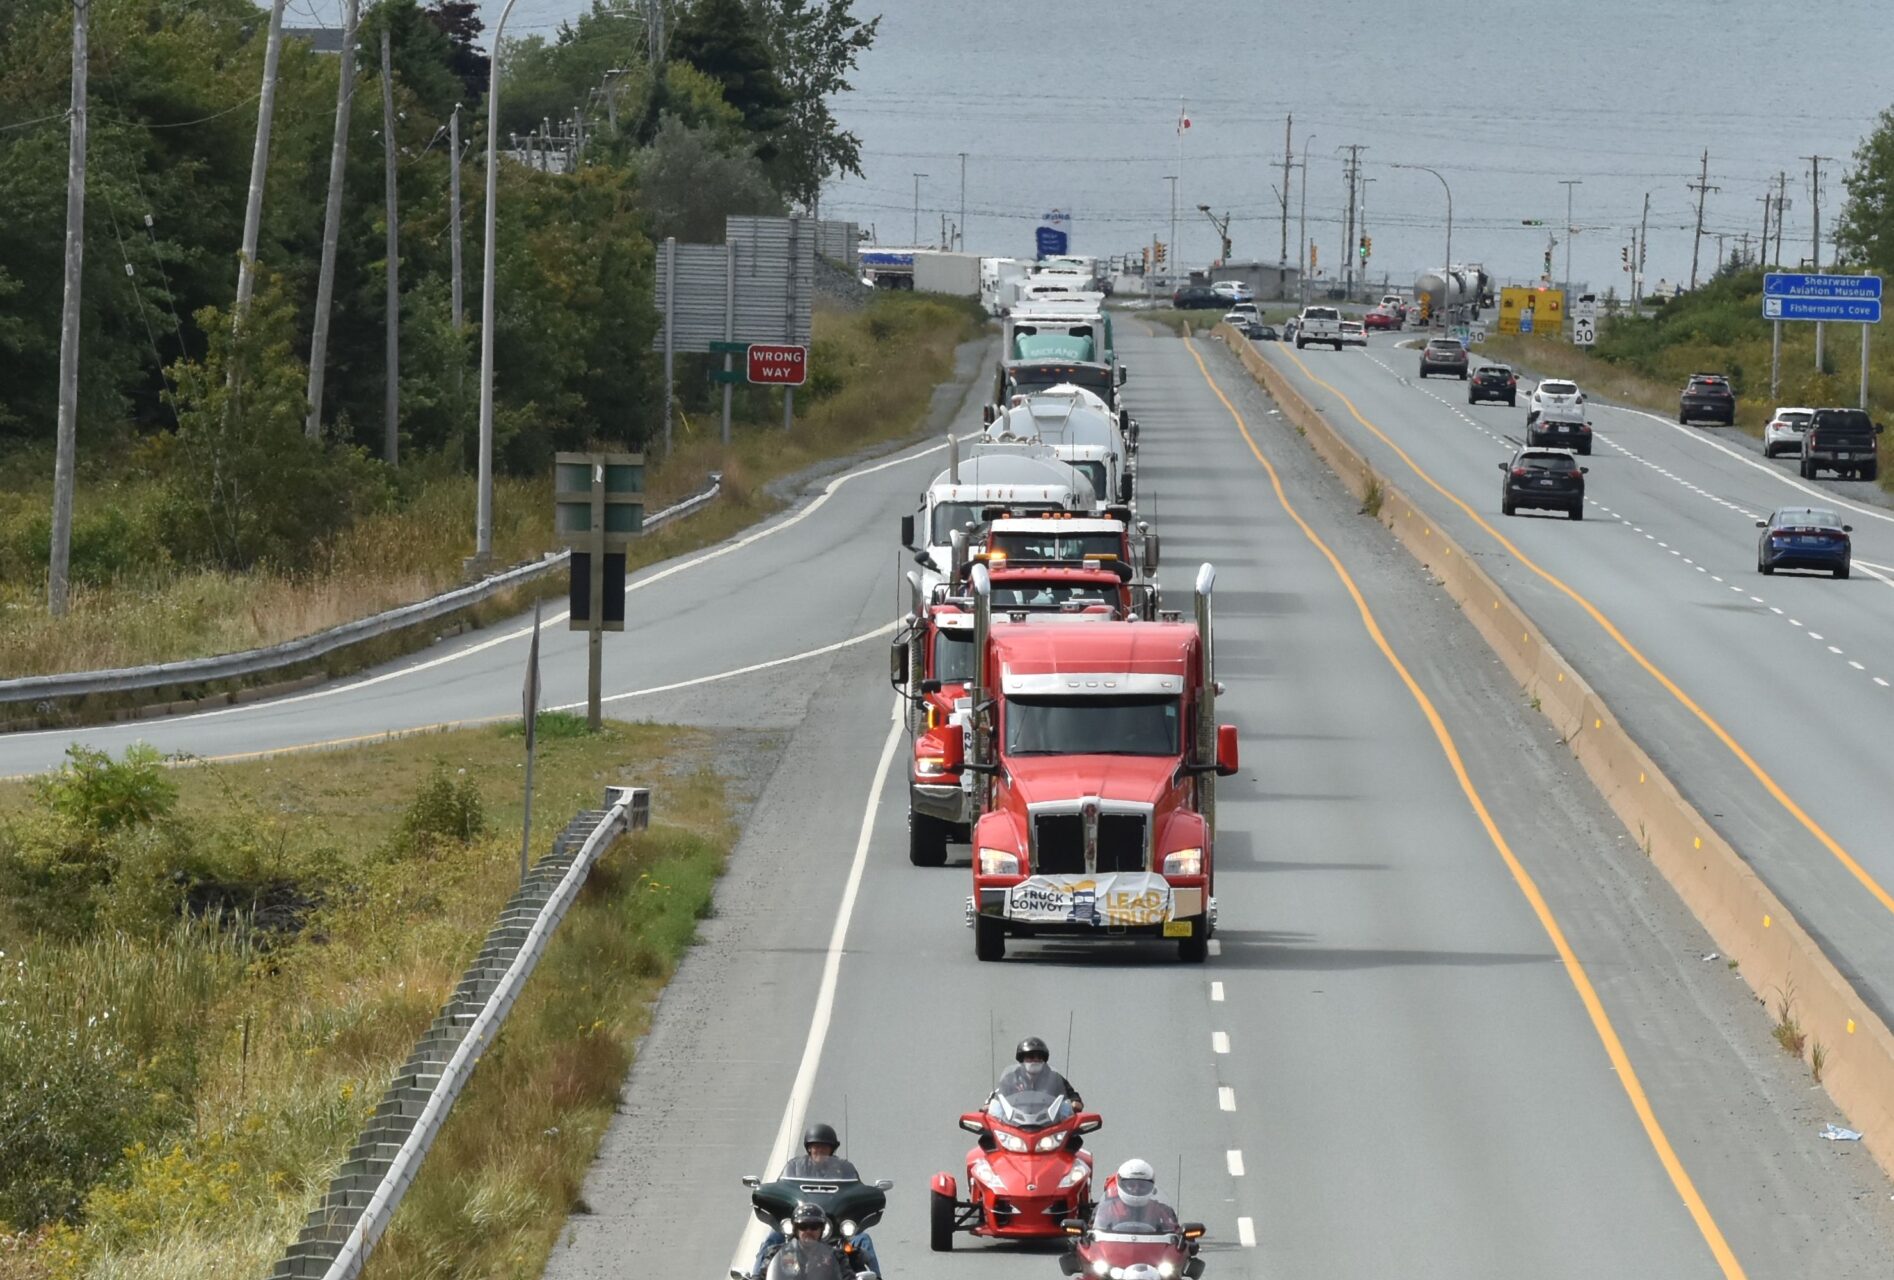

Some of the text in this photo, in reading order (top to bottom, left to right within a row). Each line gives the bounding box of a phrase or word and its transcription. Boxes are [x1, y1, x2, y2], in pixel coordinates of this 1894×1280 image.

[1804, 277, 1860, 286] Shearwater
[1789, 286, 1875, 297] Aviation Museum
[1790, 304, 1871, 315] Fisherman's Cove
[1469, 332, 1484, 342] 50
[1576, 330, 1593, 342] 50
[753, 351, 802, 363] WRONG
[762, 367, 791, 378] WAY
[1022, 890, 1064, 903] TRUCK
[1106, 892, 1161, 909] LEAD
[1011, 900, 1063, 912] CONVOY
